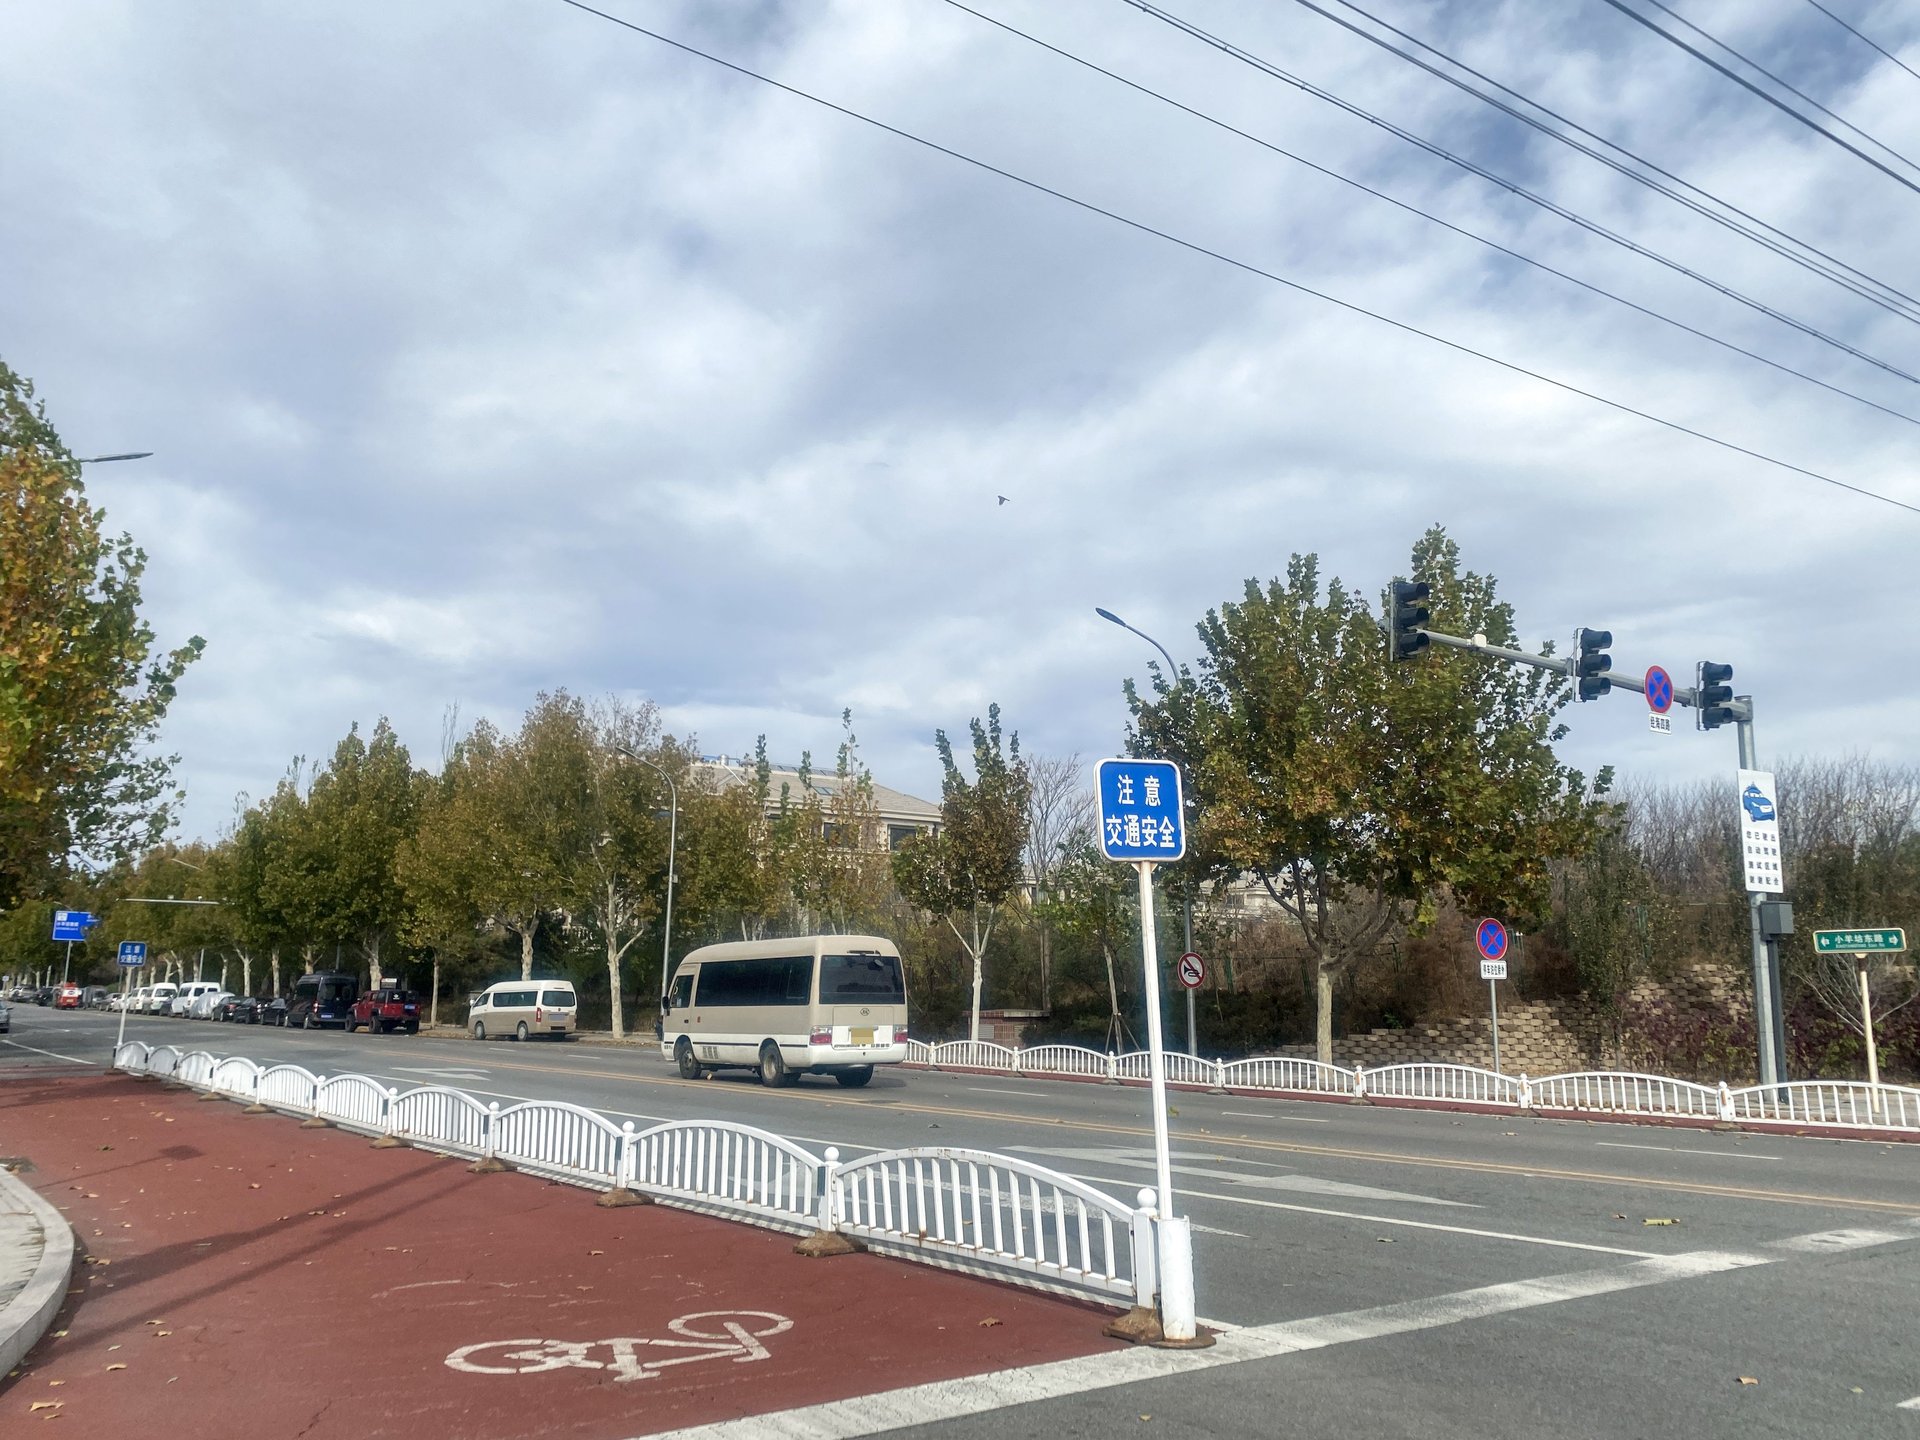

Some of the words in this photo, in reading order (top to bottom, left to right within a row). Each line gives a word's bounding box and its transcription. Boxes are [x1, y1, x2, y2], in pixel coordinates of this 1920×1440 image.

[1117, 774, 1162, 807] 注意
[1106, 814, 1175, 848] 交通安全
[1746, 830, 1776, 842] 您已驶出
[1747, 845, 1778, 857] 自动驾驶
[1748, 860, 1779, 871] 测试区域
[1749, 875, 1780, 886] 谢谢配合
